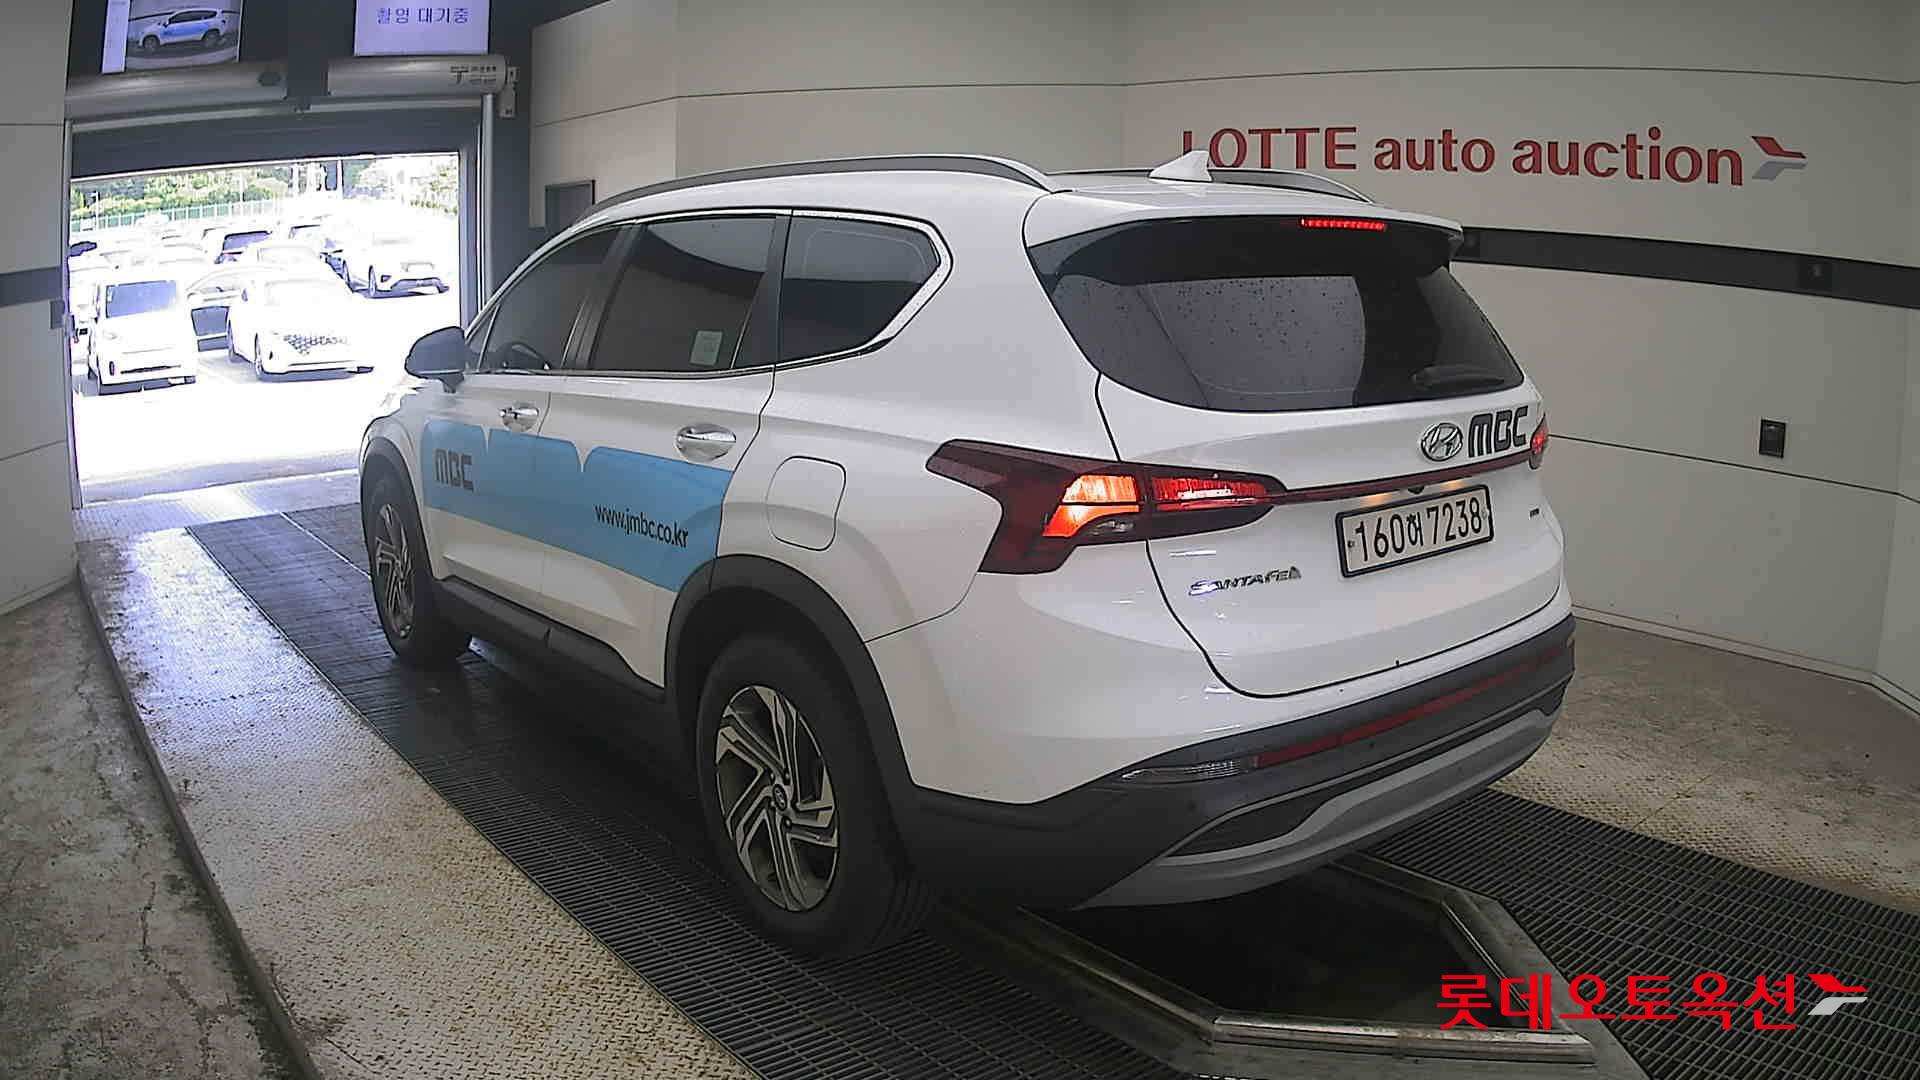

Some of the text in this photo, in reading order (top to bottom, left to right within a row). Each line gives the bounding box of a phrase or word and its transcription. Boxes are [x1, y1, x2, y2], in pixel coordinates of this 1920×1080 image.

[417, 7, 469, 24] 대기중
[1374, 128, 1495, 174] auto
[1512, 126, 1743, 186] auction
[1468, 405, 1529, 458] MBC
[435, 449, 474, 491] MBC
[595, 505, 689, 549] www.jmbc.co.kr
